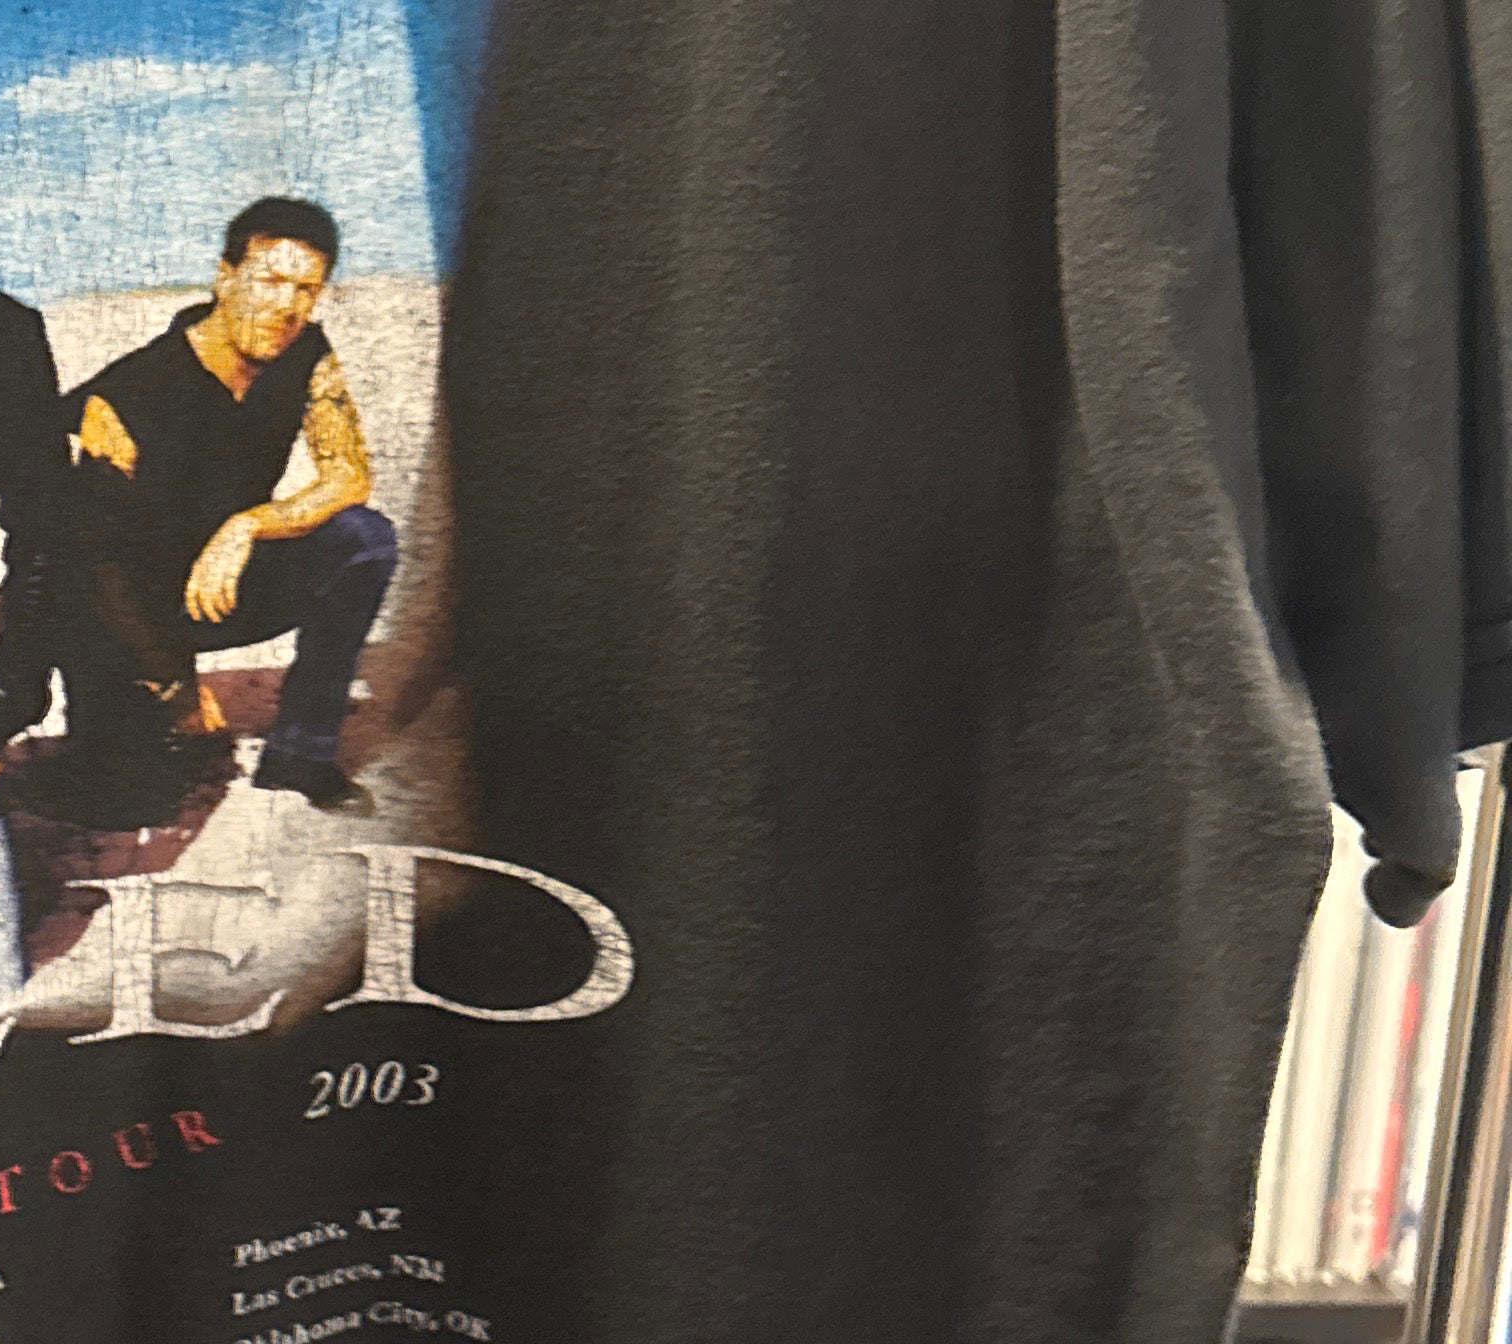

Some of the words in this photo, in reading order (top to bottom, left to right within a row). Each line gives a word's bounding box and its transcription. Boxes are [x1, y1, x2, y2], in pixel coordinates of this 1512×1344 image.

[302, 1060, 440, 1119] 2003
[232, 1220, 349, 1268] Phoenix,
[231, 1287, 281, 1317] Las
[442, 1309, 492, 1342] OK
